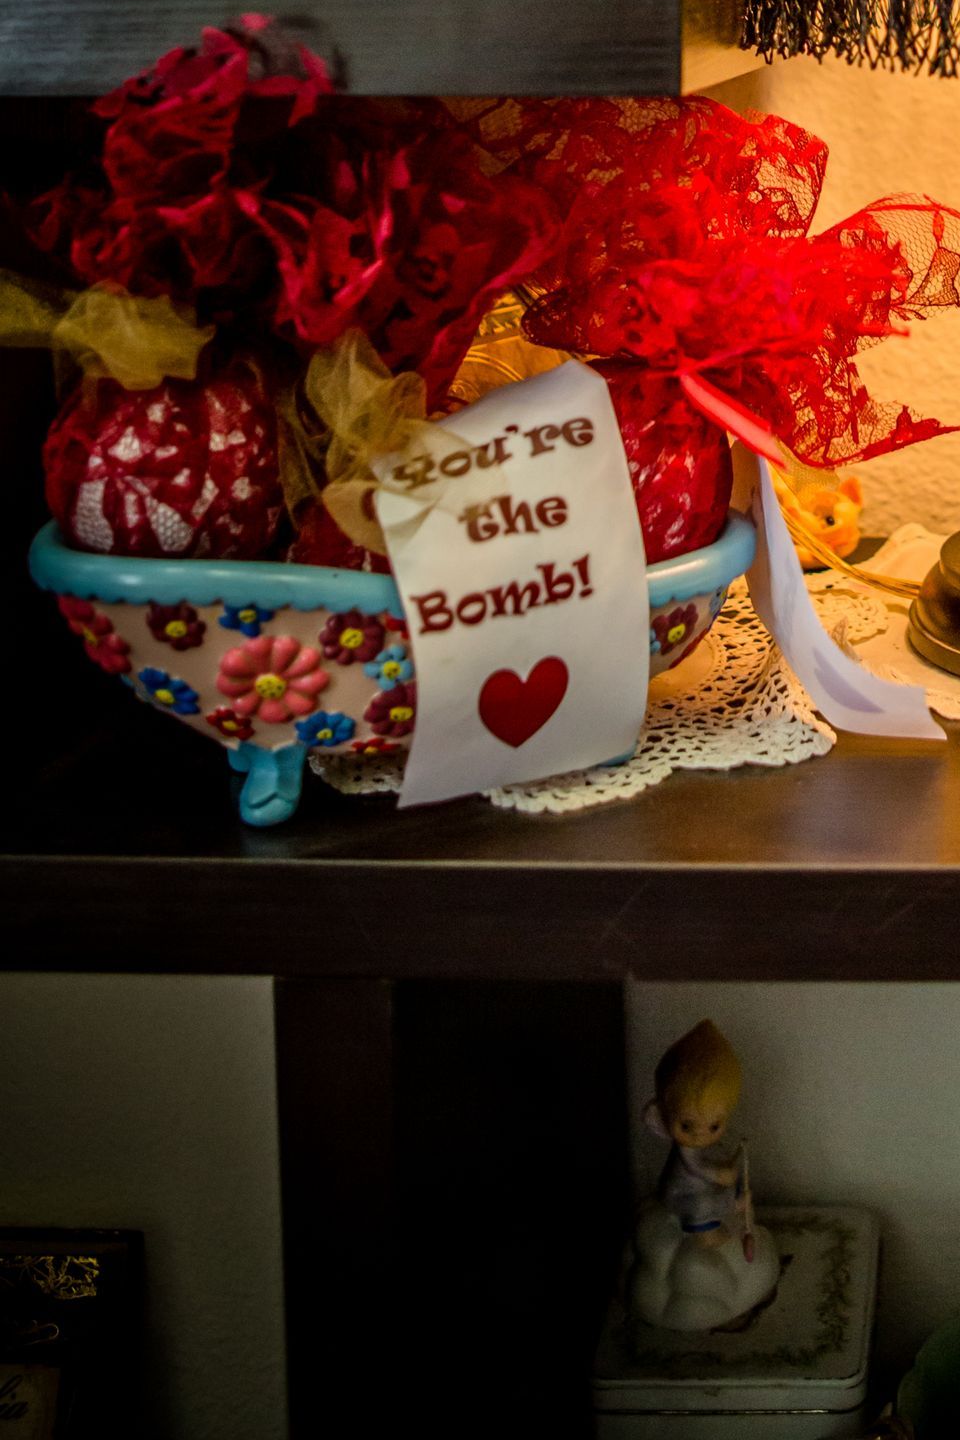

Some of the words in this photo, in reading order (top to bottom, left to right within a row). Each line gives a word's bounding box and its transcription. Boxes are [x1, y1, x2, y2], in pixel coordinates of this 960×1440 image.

[392, 417, 595, 491] You're
[458, 495, 568, 544] the
[410, 554, 594, 635] Bomb!
